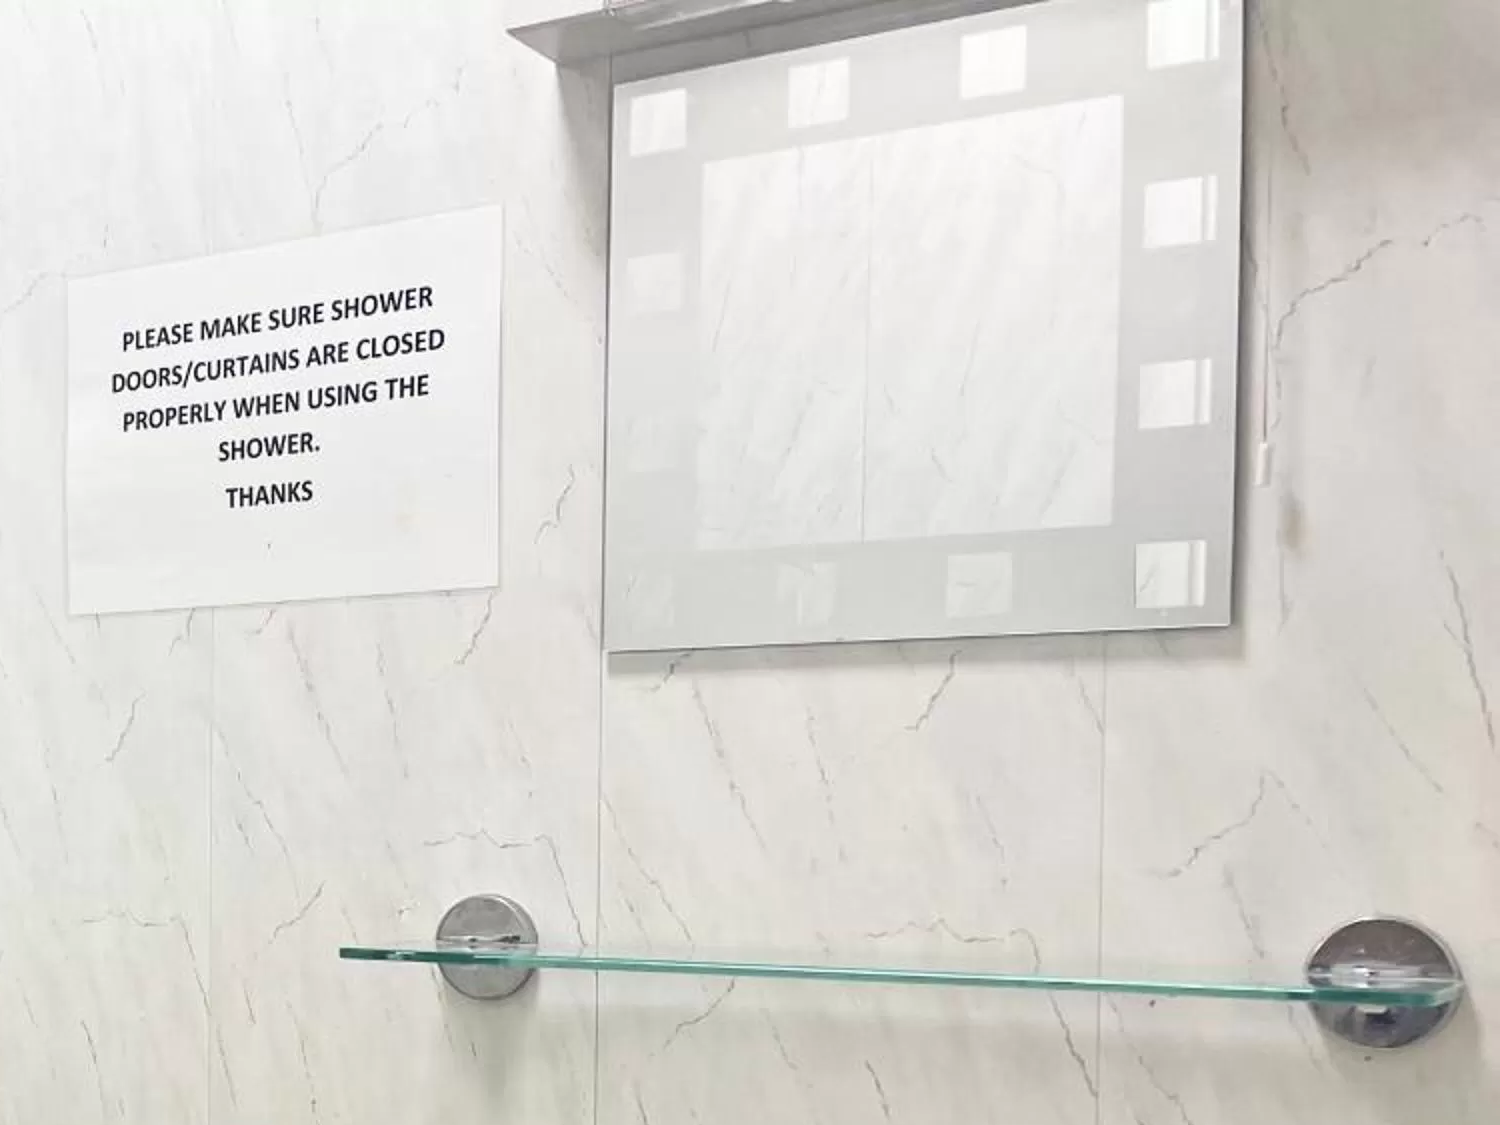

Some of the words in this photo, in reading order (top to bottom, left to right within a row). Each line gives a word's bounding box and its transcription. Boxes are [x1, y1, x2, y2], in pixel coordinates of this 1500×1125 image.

[123, 322, 194, 353] PLEASE
[200, 311, 262, 341] MAKE
[268, 302, 325, 331] SURE
[331, 286, 433, 321] SHOWER
[111, 348, 300, 394] DOORS/CURTAINS
[305, 341, 349, 368] ARE
[356, 328, 445, 361] CLOSED
[123, 399, 227, 433] PROPERLY
[232, 391, 300, 419] WHEN
[307, 381, 378, 410] USING
[384, 373, 429, 401] THE
[218, 431, 320, 462] SHOWER.
[225, 480, 313, 509] THANKS
